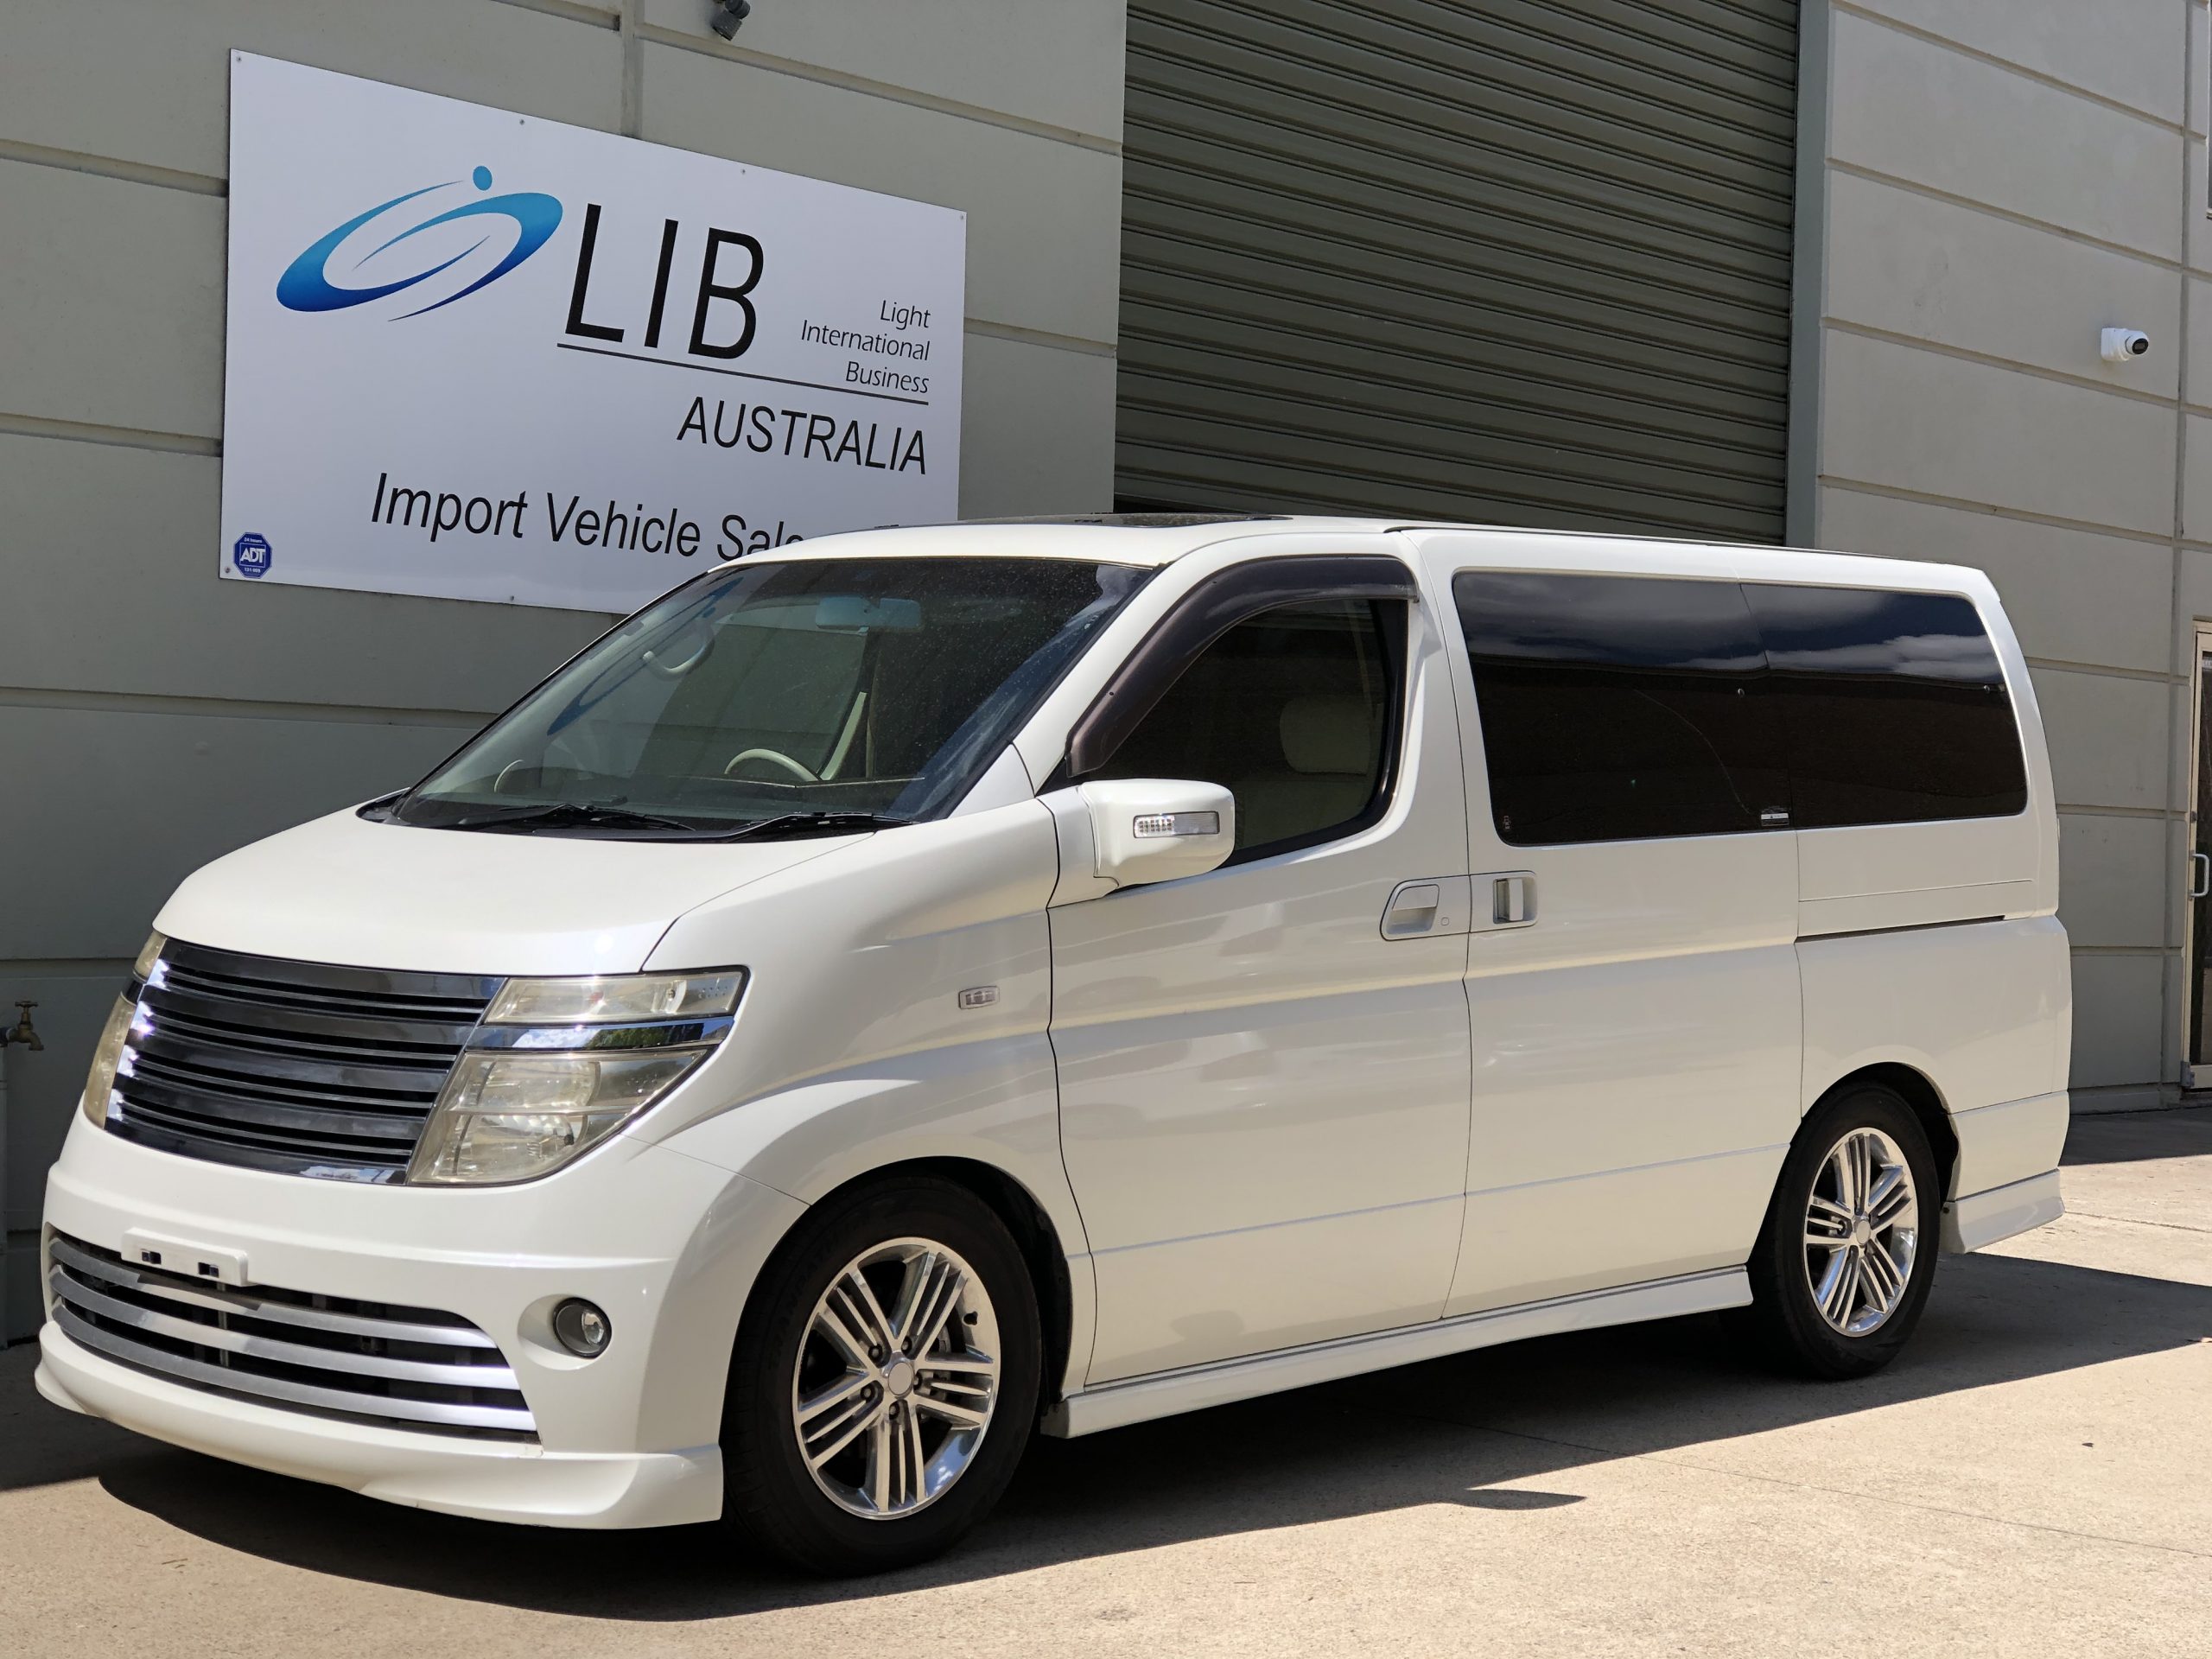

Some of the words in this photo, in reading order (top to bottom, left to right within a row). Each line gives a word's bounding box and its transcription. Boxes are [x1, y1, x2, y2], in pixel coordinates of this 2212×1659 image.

[564, 203, 765, 359] LIB
[880, 299, 931, 331] Light
[800, 319, 931, 361] International
[845, 360, 930, 394] Business
[676, 396, 927, 475] AUSTRALIA
[371, 472, 529, 543] Import
[546, 492, 702, 557] Vehicle
[240, 547, 266, 563] ADT
